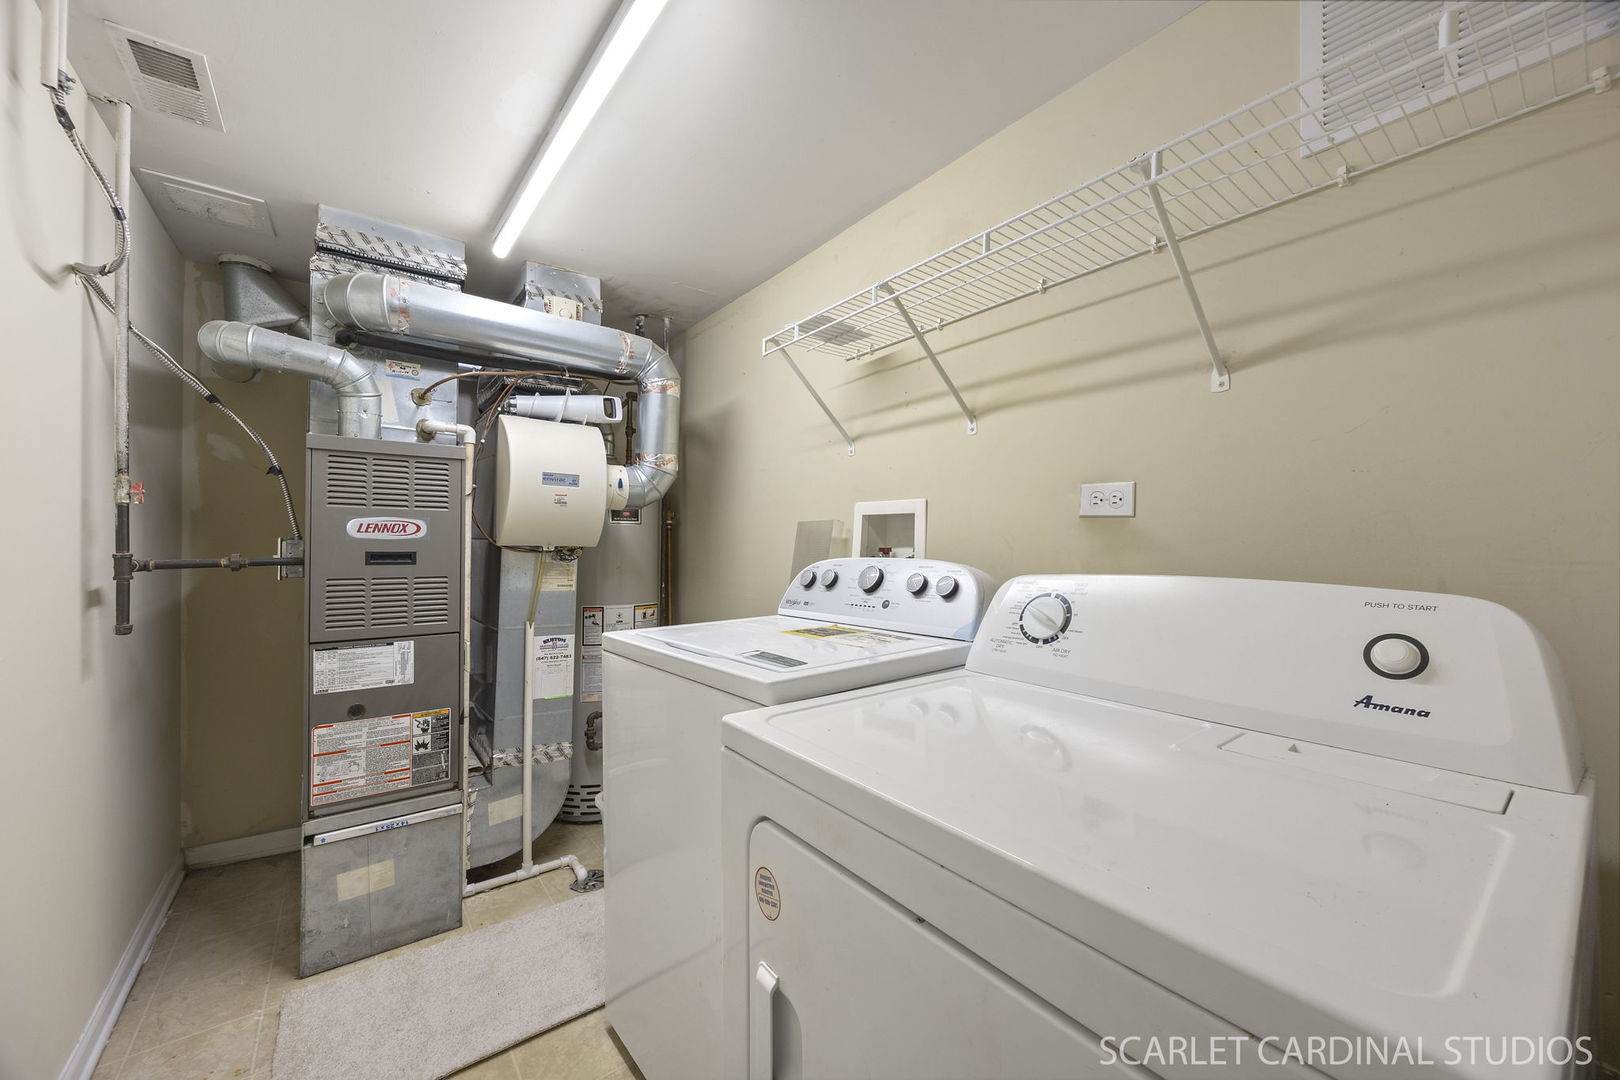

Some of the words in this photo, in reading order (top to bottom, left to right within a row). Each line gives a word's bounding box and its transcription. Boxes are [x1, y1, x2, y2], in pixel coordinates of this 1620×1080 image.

[356, 522, 410, 534] LENNOX
[1364, 601, 1390, 609] PUSH
[1407, 604, 1439, 612] START
[1353, 695, 1431, 718] Amana
